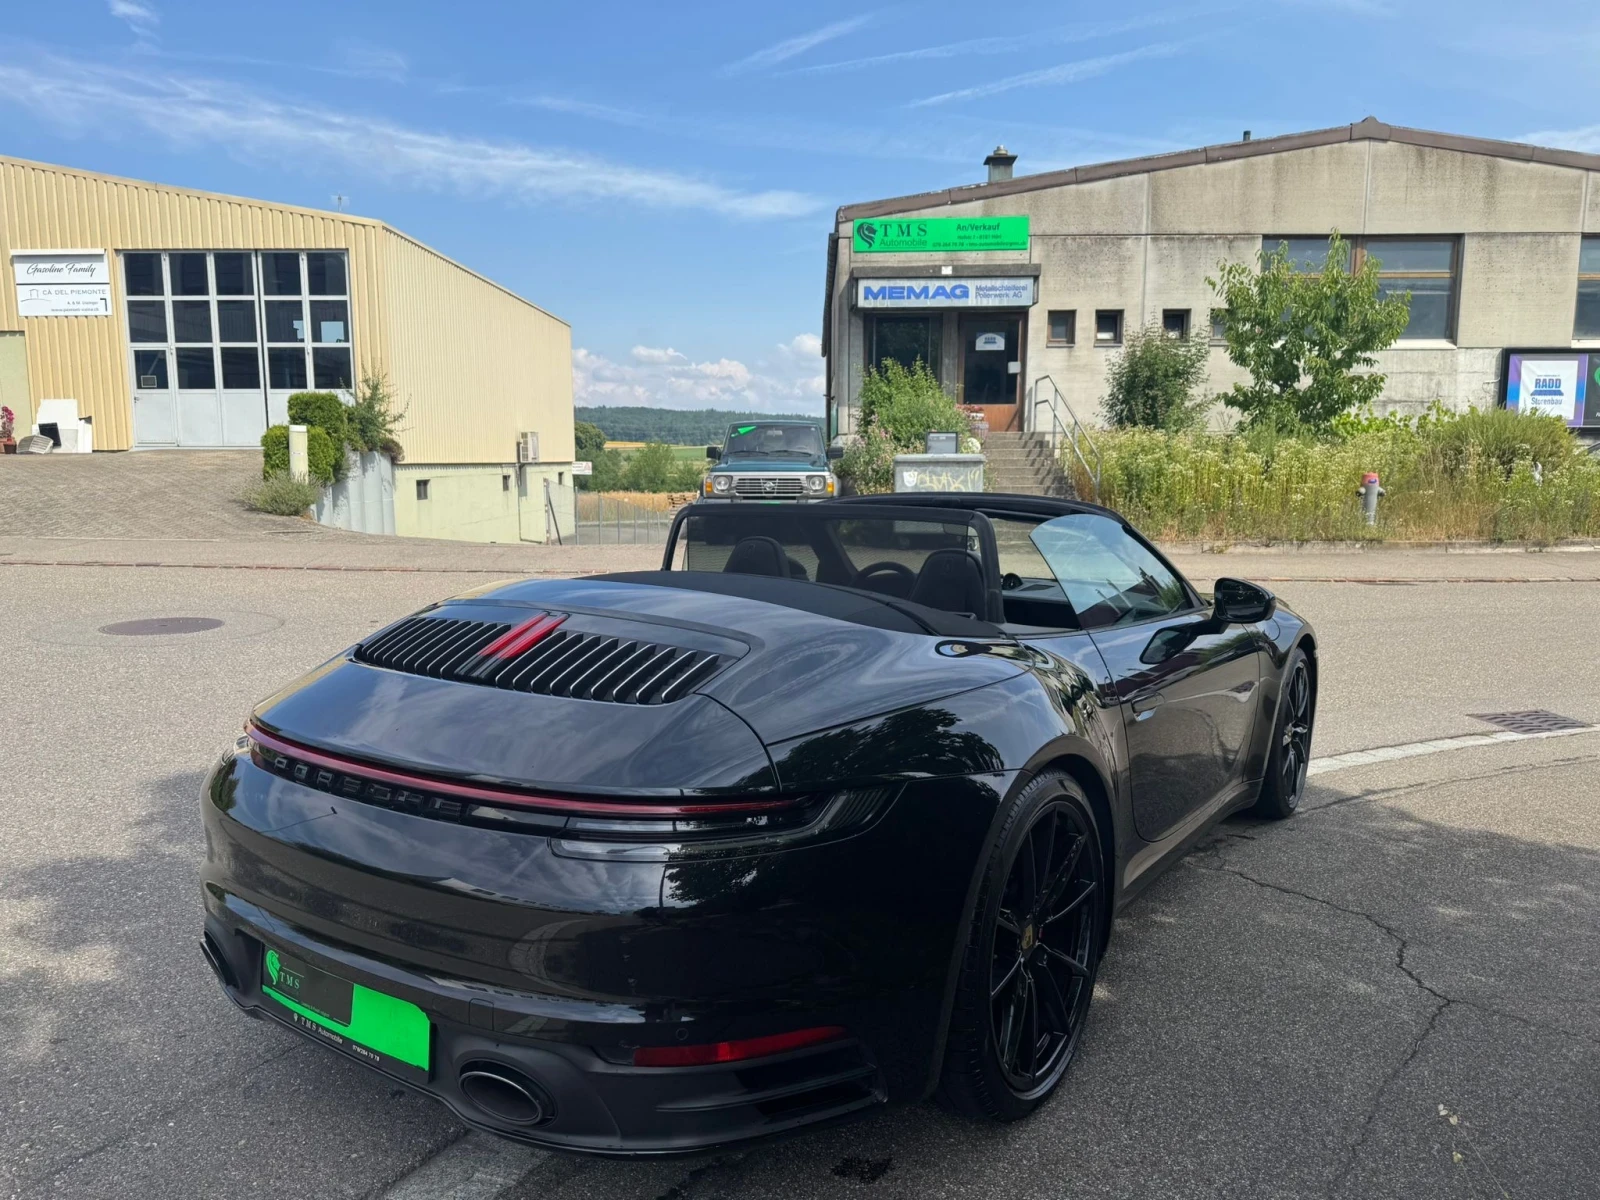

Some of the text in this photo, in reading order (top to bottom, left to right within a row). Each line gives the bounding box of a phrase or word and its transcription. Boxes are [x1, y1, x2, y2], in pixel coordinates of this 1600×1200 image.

[956, 222, 1000, 232] An/Verkauf
[879, 238, 927, 247] Automobile
[26, 263, 96, 277] Gasoline Family
[863, 284, 970, 300] MEMAG
[975, 291, 1009, 299] Polierwerk
[1535, 378, 1562, 389] RADD
[1531, 397, 1563, 405] Storenbau
[274, 756, 462, 818] PORSCHE
[318, 1027, 343, 1044] Automobile
